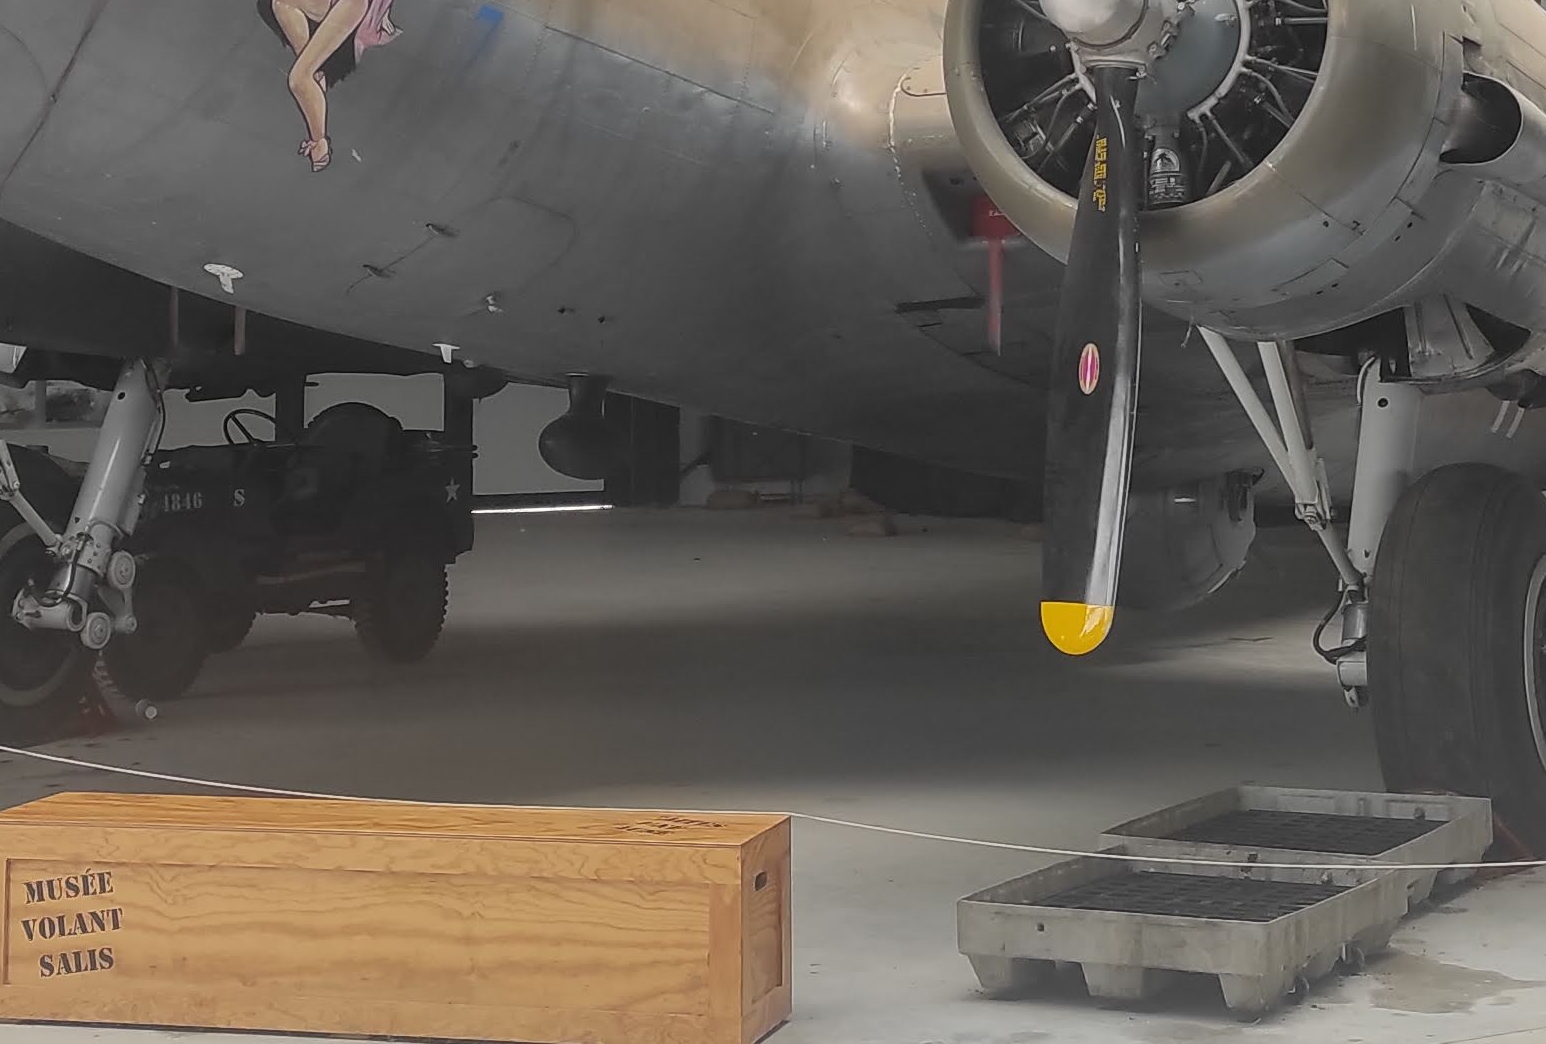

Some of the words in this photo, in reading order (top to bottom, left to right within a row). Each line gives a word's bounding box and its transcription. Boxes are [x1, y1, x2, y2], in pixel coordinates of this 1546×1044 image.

[21, 868, 114, 905] MUSÉE
[20, 907, 124, 942] VOLANT
[39, 947, 115, 978] SALIS
